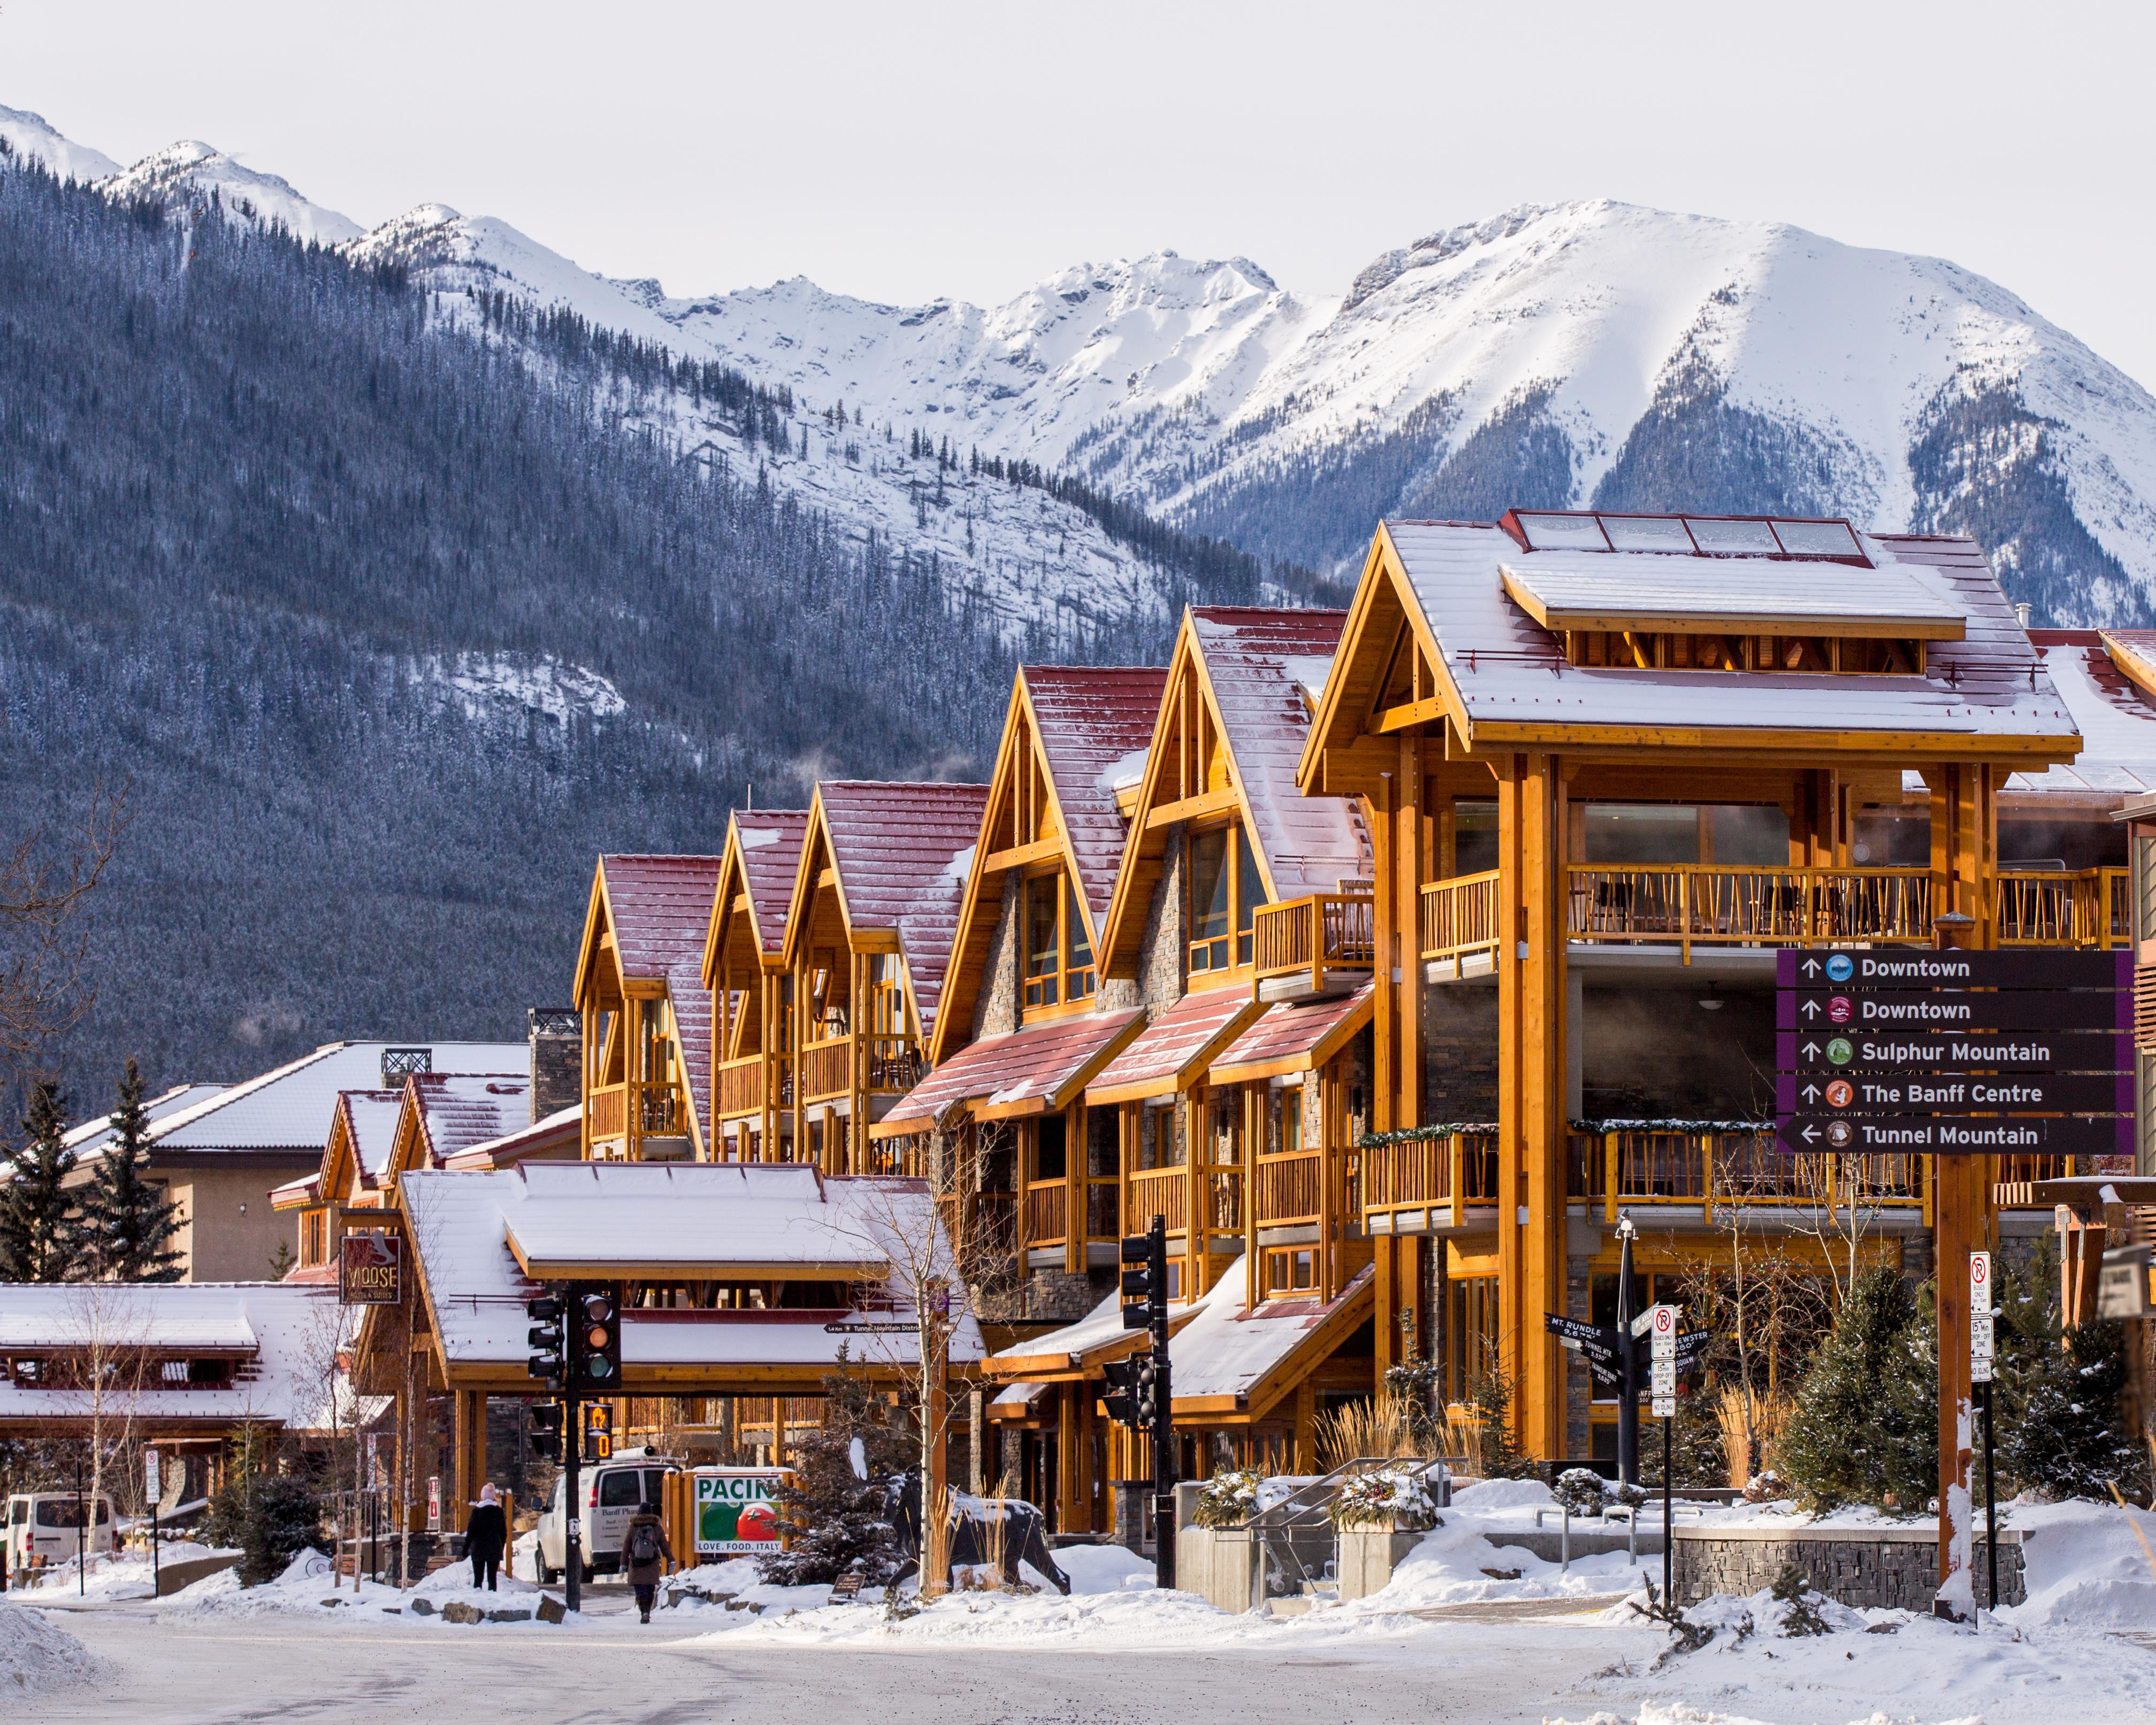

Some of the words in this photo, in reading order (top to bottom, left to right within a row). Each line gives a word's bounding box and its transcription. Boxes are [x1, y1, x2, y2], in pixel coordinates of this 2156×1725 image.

[1862, 959, 1970, 976] Downtown
[1863, 1001, 1970, 1019] Downtown
[1862, 1042, 1944, 1064] Sulphur
[1952, 1043, 2050, 1060] Mountain
[1862, 1085, 1900, 1102] The
[1908, 1084, 1964, 1102] Banff
[1972, 1085, 2042, 1102] Centre
[1862, 1126, 1931, 1143] Tunnel
[1940, 1126, 2038, 1144] Mountain
[346, 1266, 396, 1287] MOOSE
[1642, 1310, 1652, 1321] AYLM
[1551, 1318, 1564, 1326] MT.
[1566, 1321, 1602, 1336] RUNDLE
[1972, 1322, 1978, 1332] 15
[1981, 1323, 1989, 1332] Min
[1585, 1340, 1602, 1354] TUNNEL
[1675, 1332, 1708, 1345] REWSTER
[1592, 1362, 1608, 1376] FAIRHOLME
[1676, 1356, 1694, 1367] SQUAW
[599, 1436, 609, 1457] 0
[699, 1478, 782, 1499] PACIN
[602, 1508, 620, 1516] Banff
